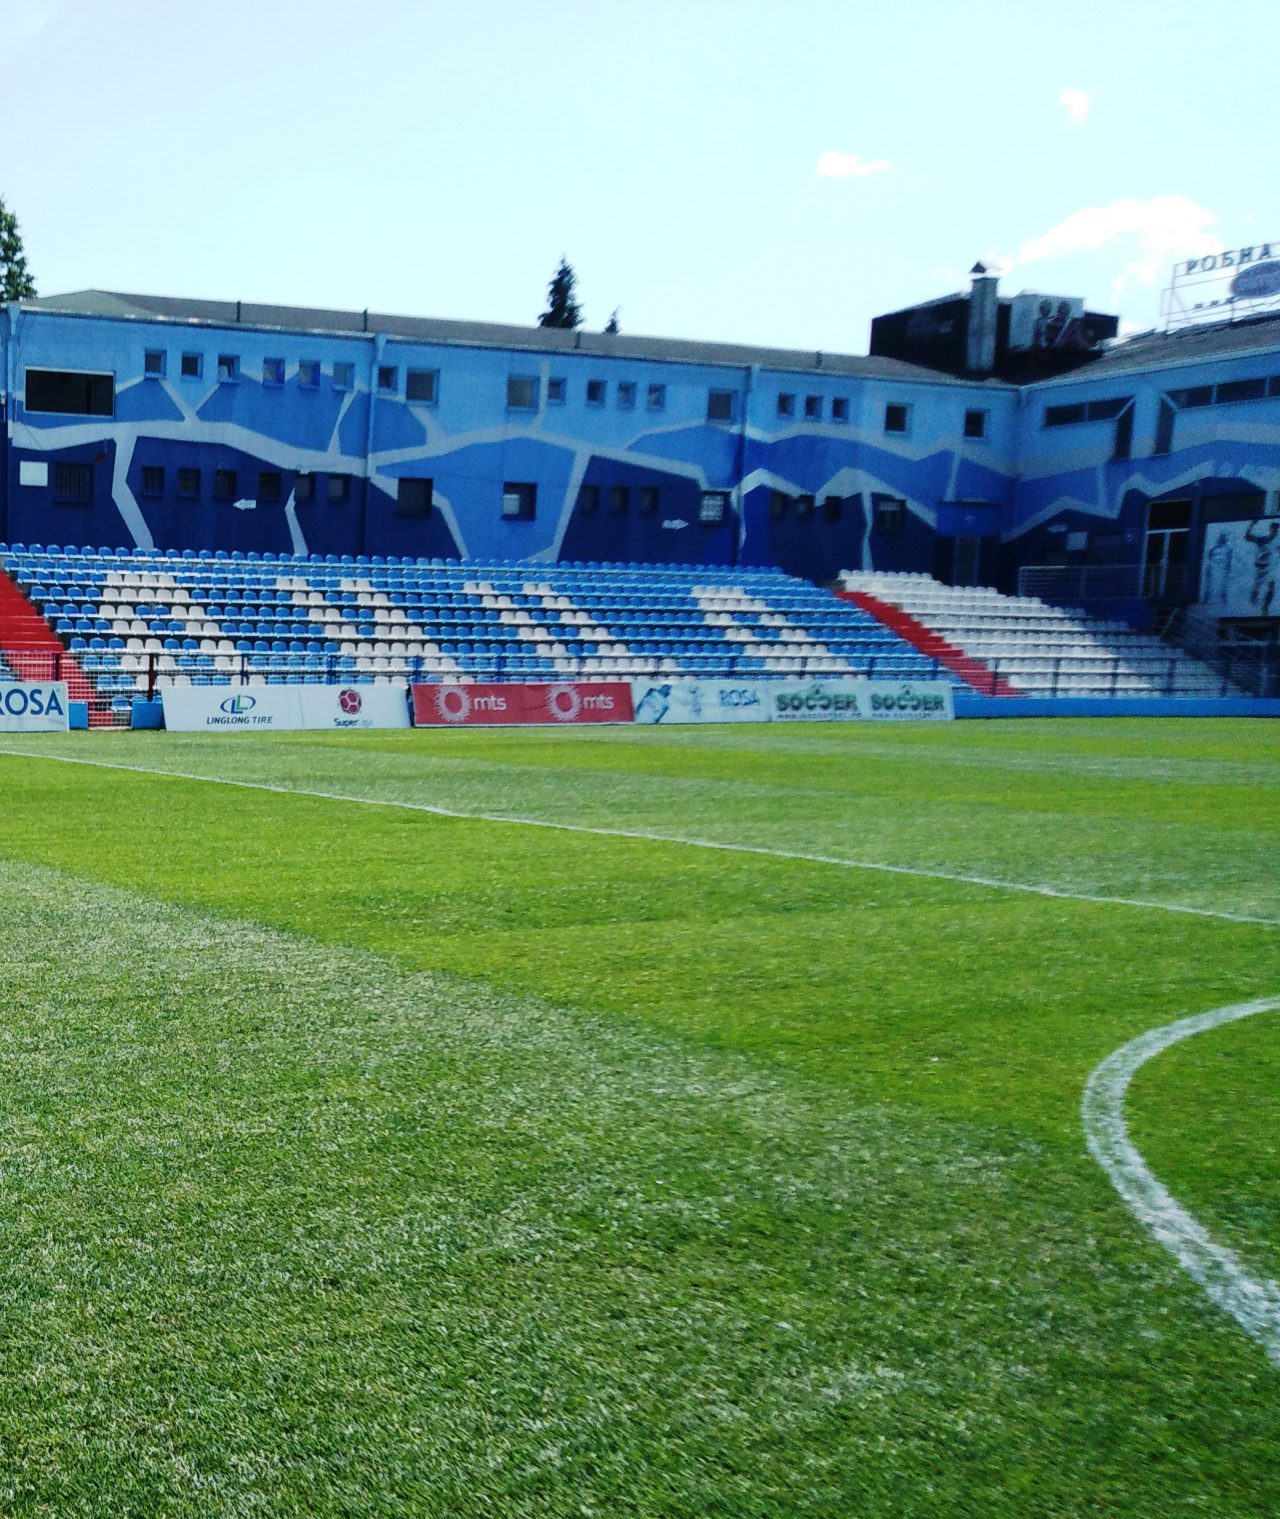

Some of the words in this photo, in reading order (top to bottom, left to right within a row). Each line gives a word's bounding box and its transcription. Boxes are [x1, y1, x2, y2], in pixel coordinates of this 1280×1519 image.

[474, 694, 507, 711] mts
[583, 695, 615, 710] mts
[719, 689, 761, 706] ROSA
[206, 716, 250, 725] LINGLONG
[252, 715, 273, 724] TIRE
